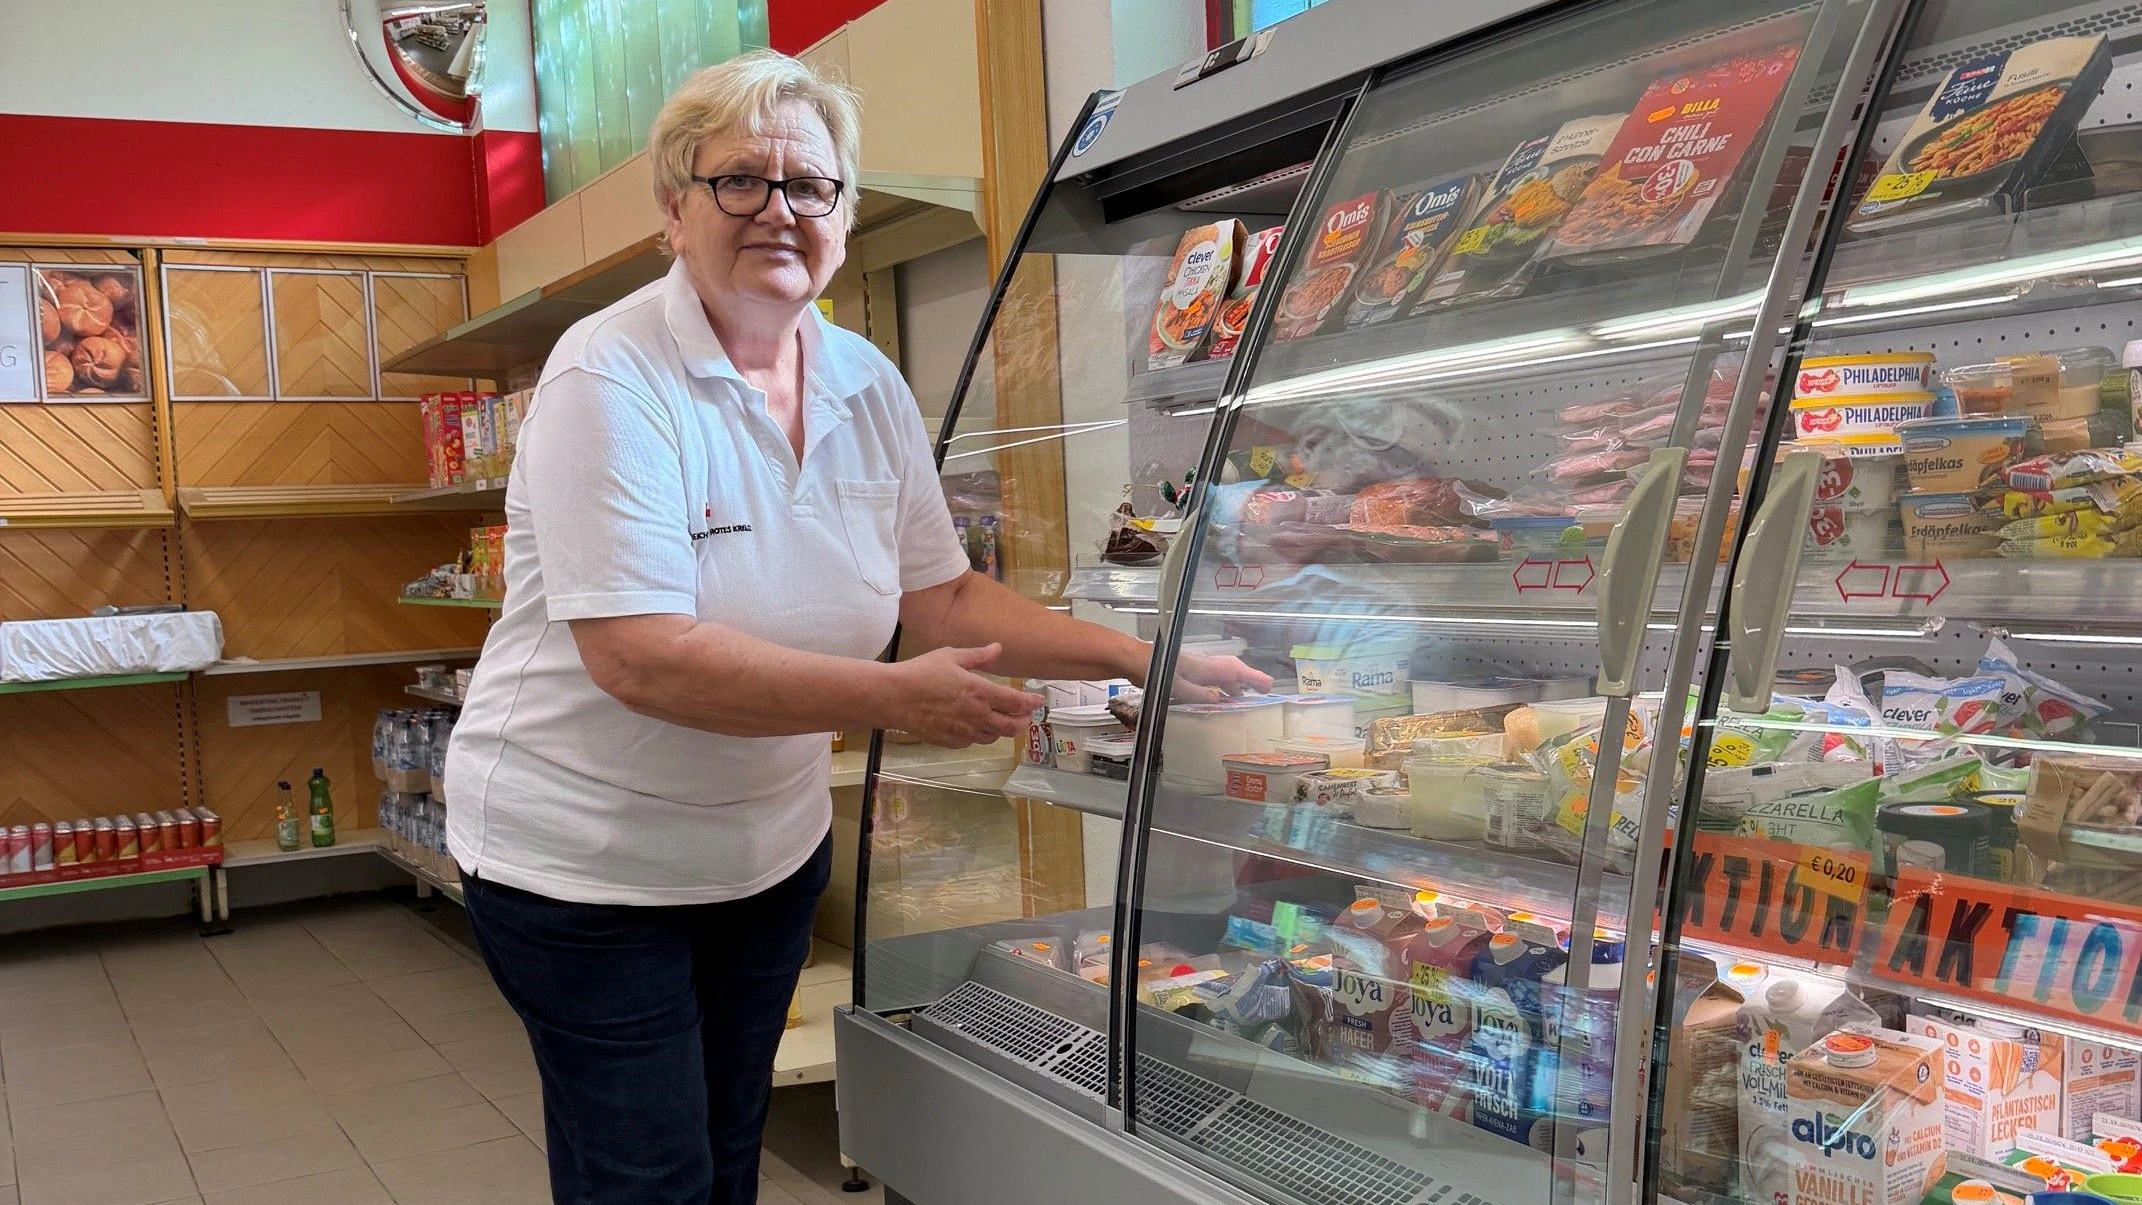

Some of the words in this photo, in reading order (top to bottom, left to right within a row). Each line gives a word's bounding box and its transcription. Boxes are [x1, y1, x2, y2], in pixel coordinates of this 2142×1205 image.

[1680, 98, 1720, 115] BILLA
[1660, 121, 1712, 144] CHILI
[1624, 144, 1667, 164] CON
[1666, 133, 1733, 160] CARNE
[1415, 186, 1462, 216] Omis
[1327, 202, 1370, 234] Omis
[1187, 250, 1214, 265] clever
[1843, 365, 1920, 386] PHILADELPHIA
[1845, 404, 1922, 425] PHILADELPHIA
[1907, 457, 1964, 474] däpfelkas
[710, 526, 732, 536] ROTES
[1302, 676, 1322, 688] Rama
[1352, 670, 1394, 689] Rama
[1882, 706, 1931, 723] clever
[1717, 715, 1764, 740] RELLA
[1746, 802, 1844, 824] ZZARELLA
[1768, 822, 1799, 837] GHT
[1811, 855, 1821, 872] €
[1823, 857, 1856, 884] 0,20
[1674, 849, 1857, 952] KTION
[1335, 968, 1383, 1004] Joya
[1347, 1017, 1368, 1028] FRESH
[1341, 1026, 1374, 1051] HAFER
[1749, 1043, 1794, 1066] cler
[1742, 1072, 1788, 1101] VOLLMIL
[1991, 1093, 2056, 1120] PFLANTASTISCH
[1791, 1110, 1877, 1161] alpro
[1912, 1124, 1942, 1142] CALCIUM
[1906, 1140, 1932, 1158] VITAMIN
[1795, 1168, 1874, 1205] VANILLE
